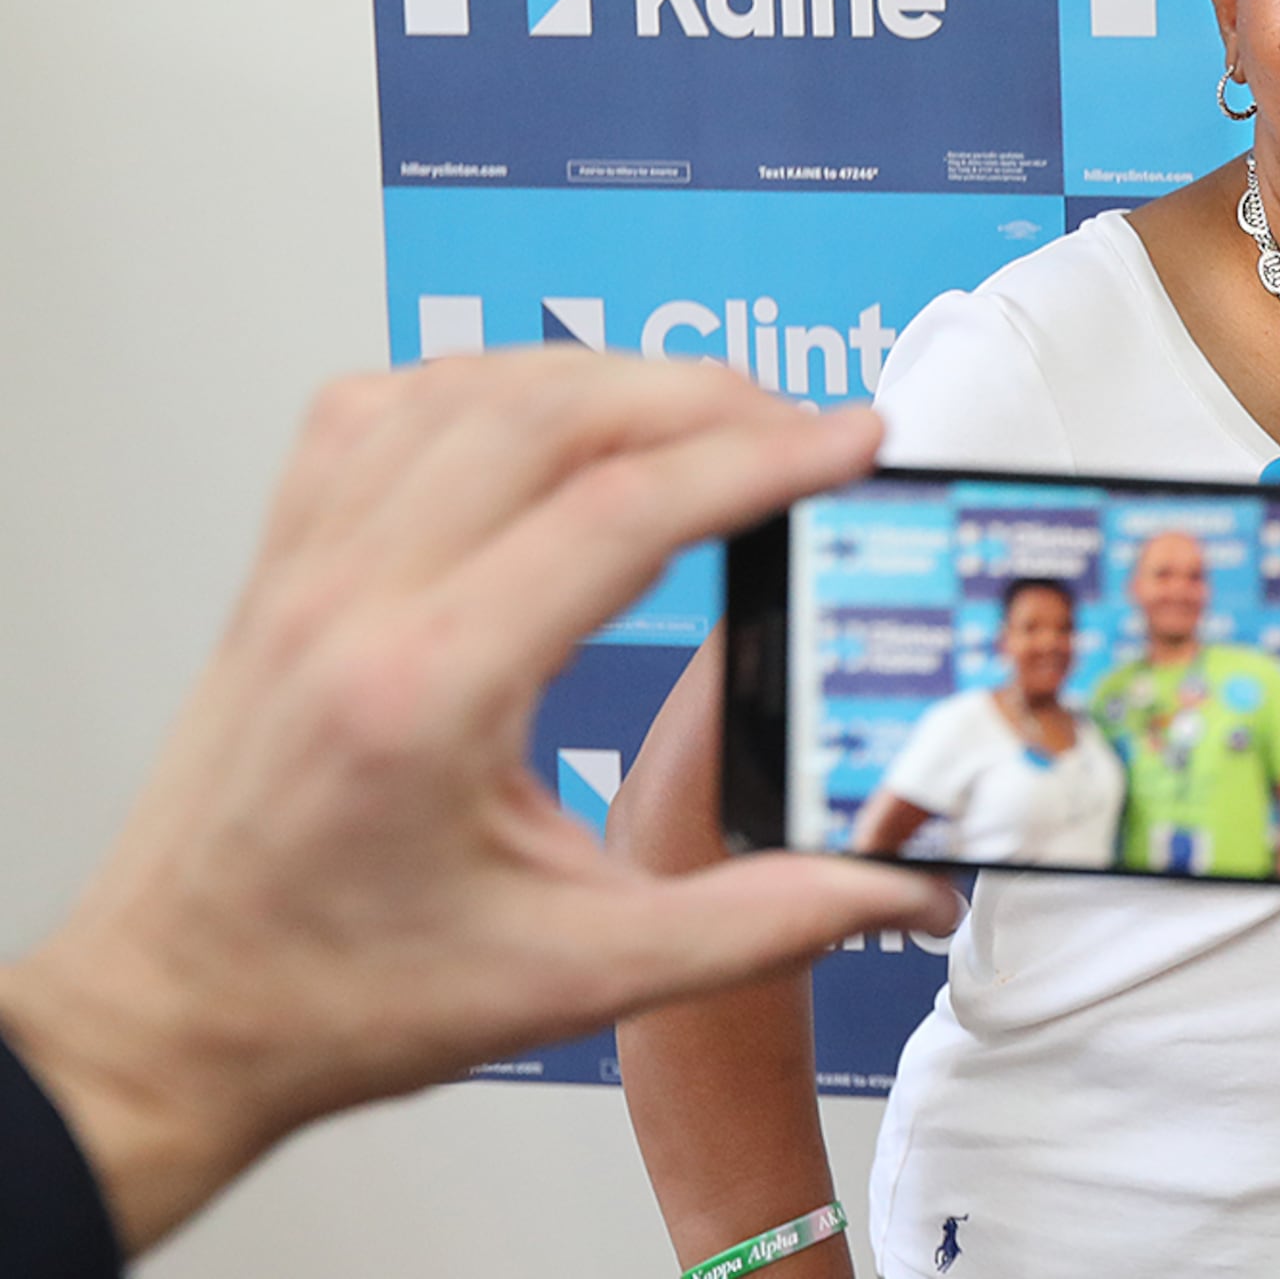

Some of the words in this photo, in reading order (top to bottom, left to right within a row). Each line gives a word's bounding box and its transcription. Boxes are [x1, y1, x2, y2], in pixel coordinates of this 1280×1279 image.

[641, 296, 896, 396] Clint
[748, 1231, 798, 1265] Alpha
[819, 1207, 844, 1232] AK
